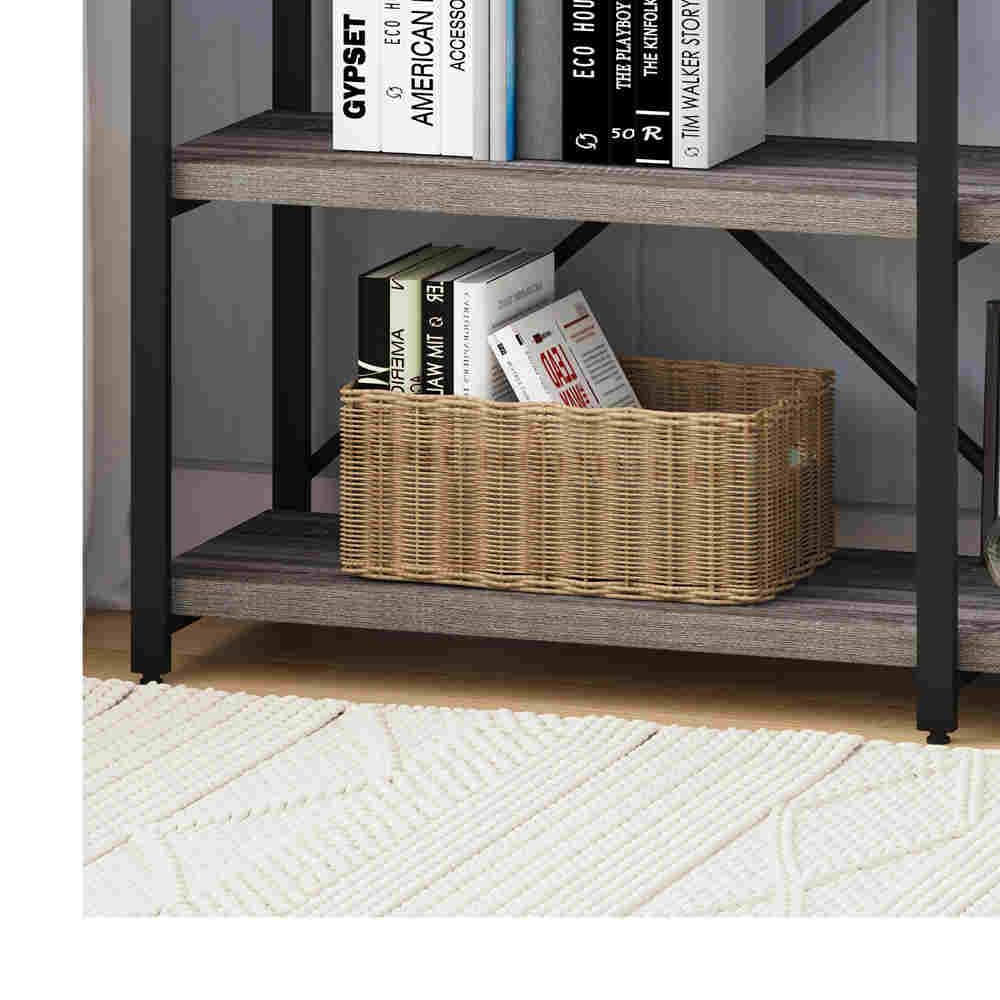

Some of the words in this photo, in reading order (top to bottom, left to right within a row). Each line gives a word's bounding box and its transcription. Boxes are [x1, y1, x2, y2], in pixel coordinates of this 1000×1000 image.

[384, 20, 401, 45] ECO
[615, 1, 632, 61] PLAYBOY
[681, 0, 701, 45] STORY
[343, 14, 366, 119] GYPSET
[411, 10, 434, 126] AMERICAN
[573, 45, 596, 78] ECO
[615, 64, 632, 90] THE
[643, 53, 659, 77] THE
[681, 50, 701, 109] WALKER
[642, 125, 664, 141] R
[681, 115, 700, 139] TIM
